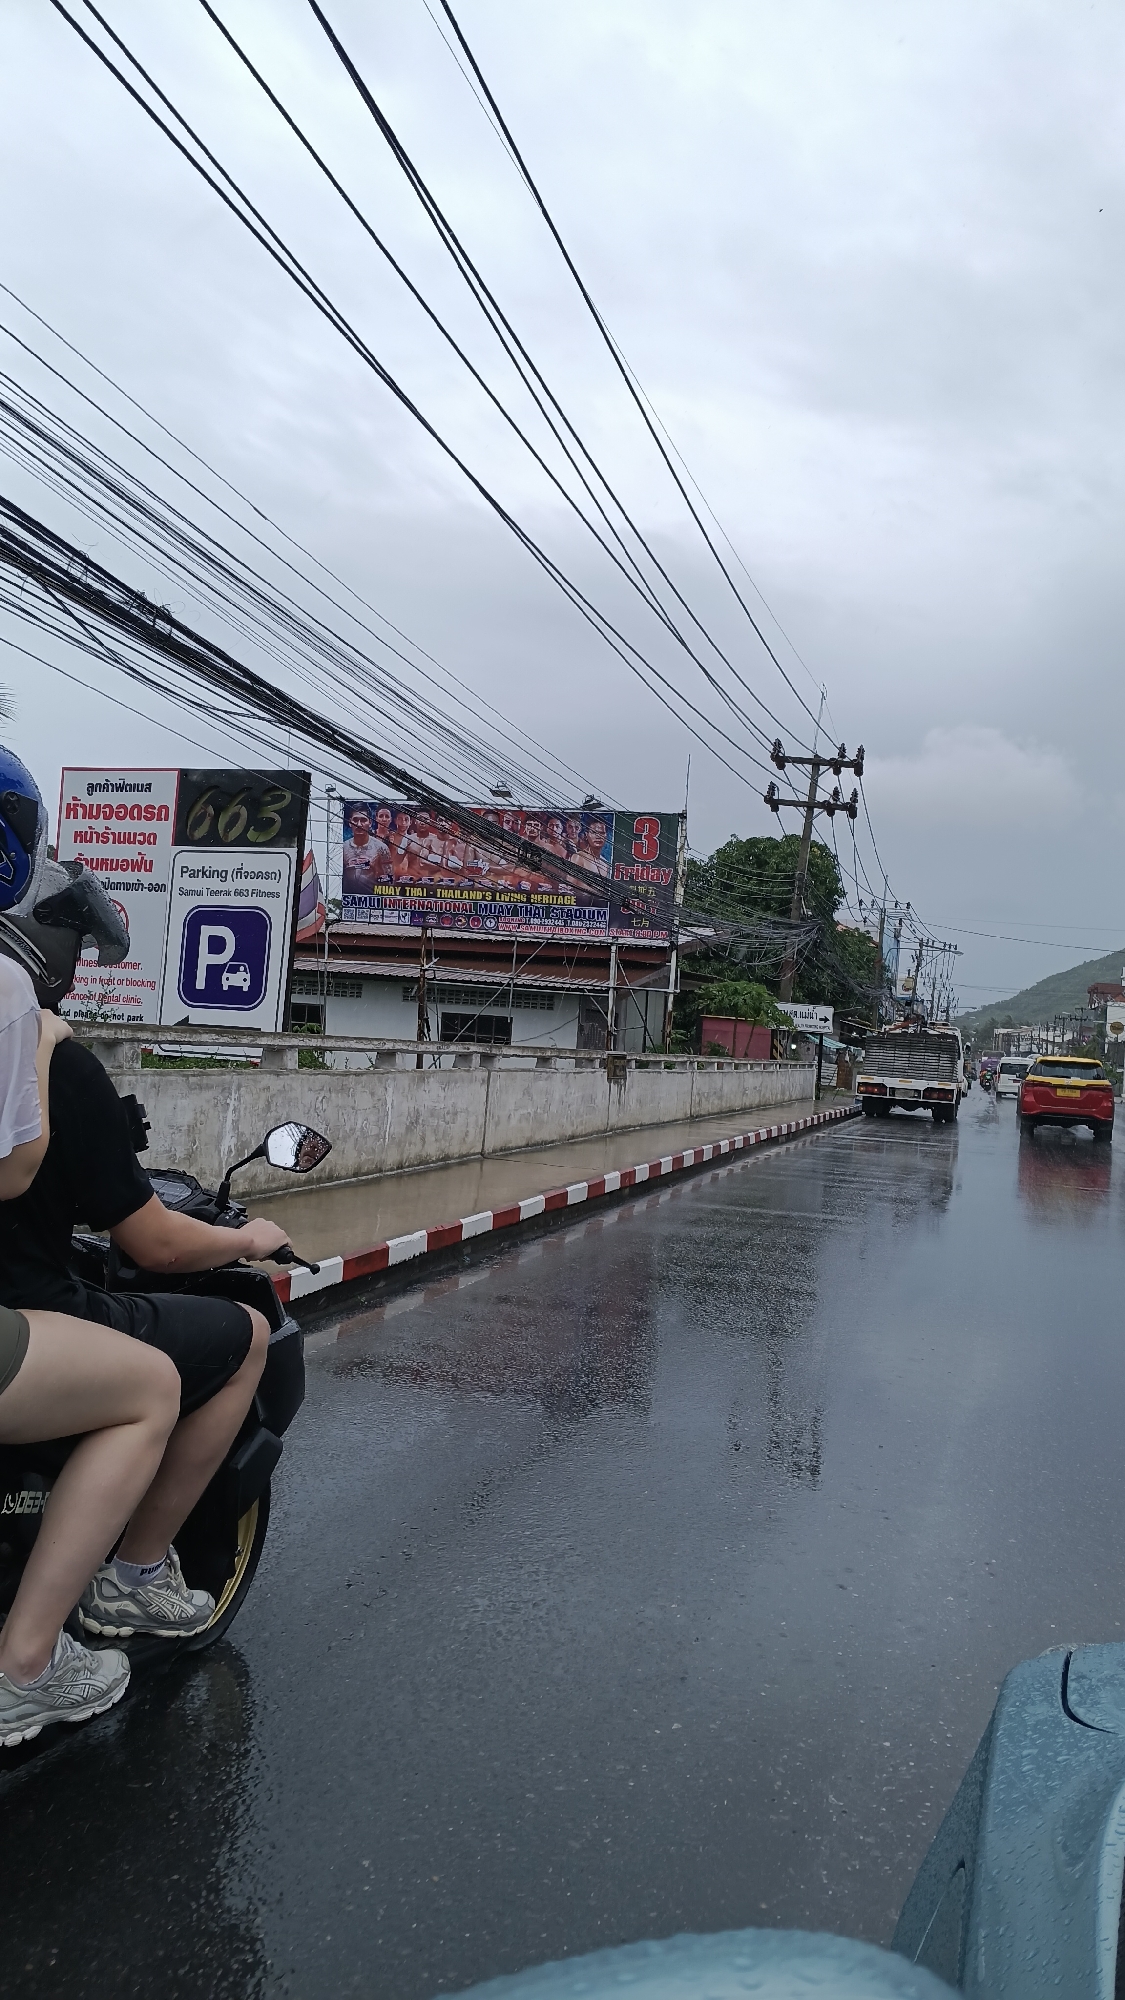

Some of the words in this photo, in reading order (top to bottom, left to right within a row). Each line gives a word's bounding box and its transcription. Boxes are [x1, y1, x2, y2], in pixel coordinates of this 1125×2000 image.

[86, 778, 152, 796] ลูกค้าฟิตเนส
[65, 796, 170, 821] ห้ามจอดรถ
[185, 784, 292, 843] 663
[73, 826, 158, 846] หน้าร้านนวด
[632, 816, 661, 862] 3
[180, 866, 229, 883] Parking
[231, 863, 281, 884] (ที่จอดรถ)
[614, 862, 673, 886] Friday
[100, 877, 167, 893] ปิดทางเข้า-ออก
[178, 887, 204, 897] Samui
[206, 887, 232, 898] Teerak
[233, 889, 250, 898] 663
[250, 888, 281, 899] Fitness
[373, 885, 402, 896] MUAY
[405, 887, 427, 897] THAI
[436, 889, 493, 900] THAILAND'S
[342, 895, 381, 909] SAMUI
[382, 897, 476, 915] INTERNATIONAL
[478, 902, 514, 917] MUAY
[517, 904, 546, 918] THAI
[549, 906, 608, 921] STADIUM
[195, 924, 235, 990] P
[73, 974, 89, 987] king
[90, 975, 97, 985] in
[116, 978, 124, 986] or
[125, 977, 157, 990] blocking
[63, 991, 87, 1001] ntrance
[88, 992, 97, 1001] of
[98, 993, 121, 1004] Dental
[122, 995, 143, 1005] clinic.
[112, 1011, 125, 1021] not
[126, 1013, 144, 1022] park
